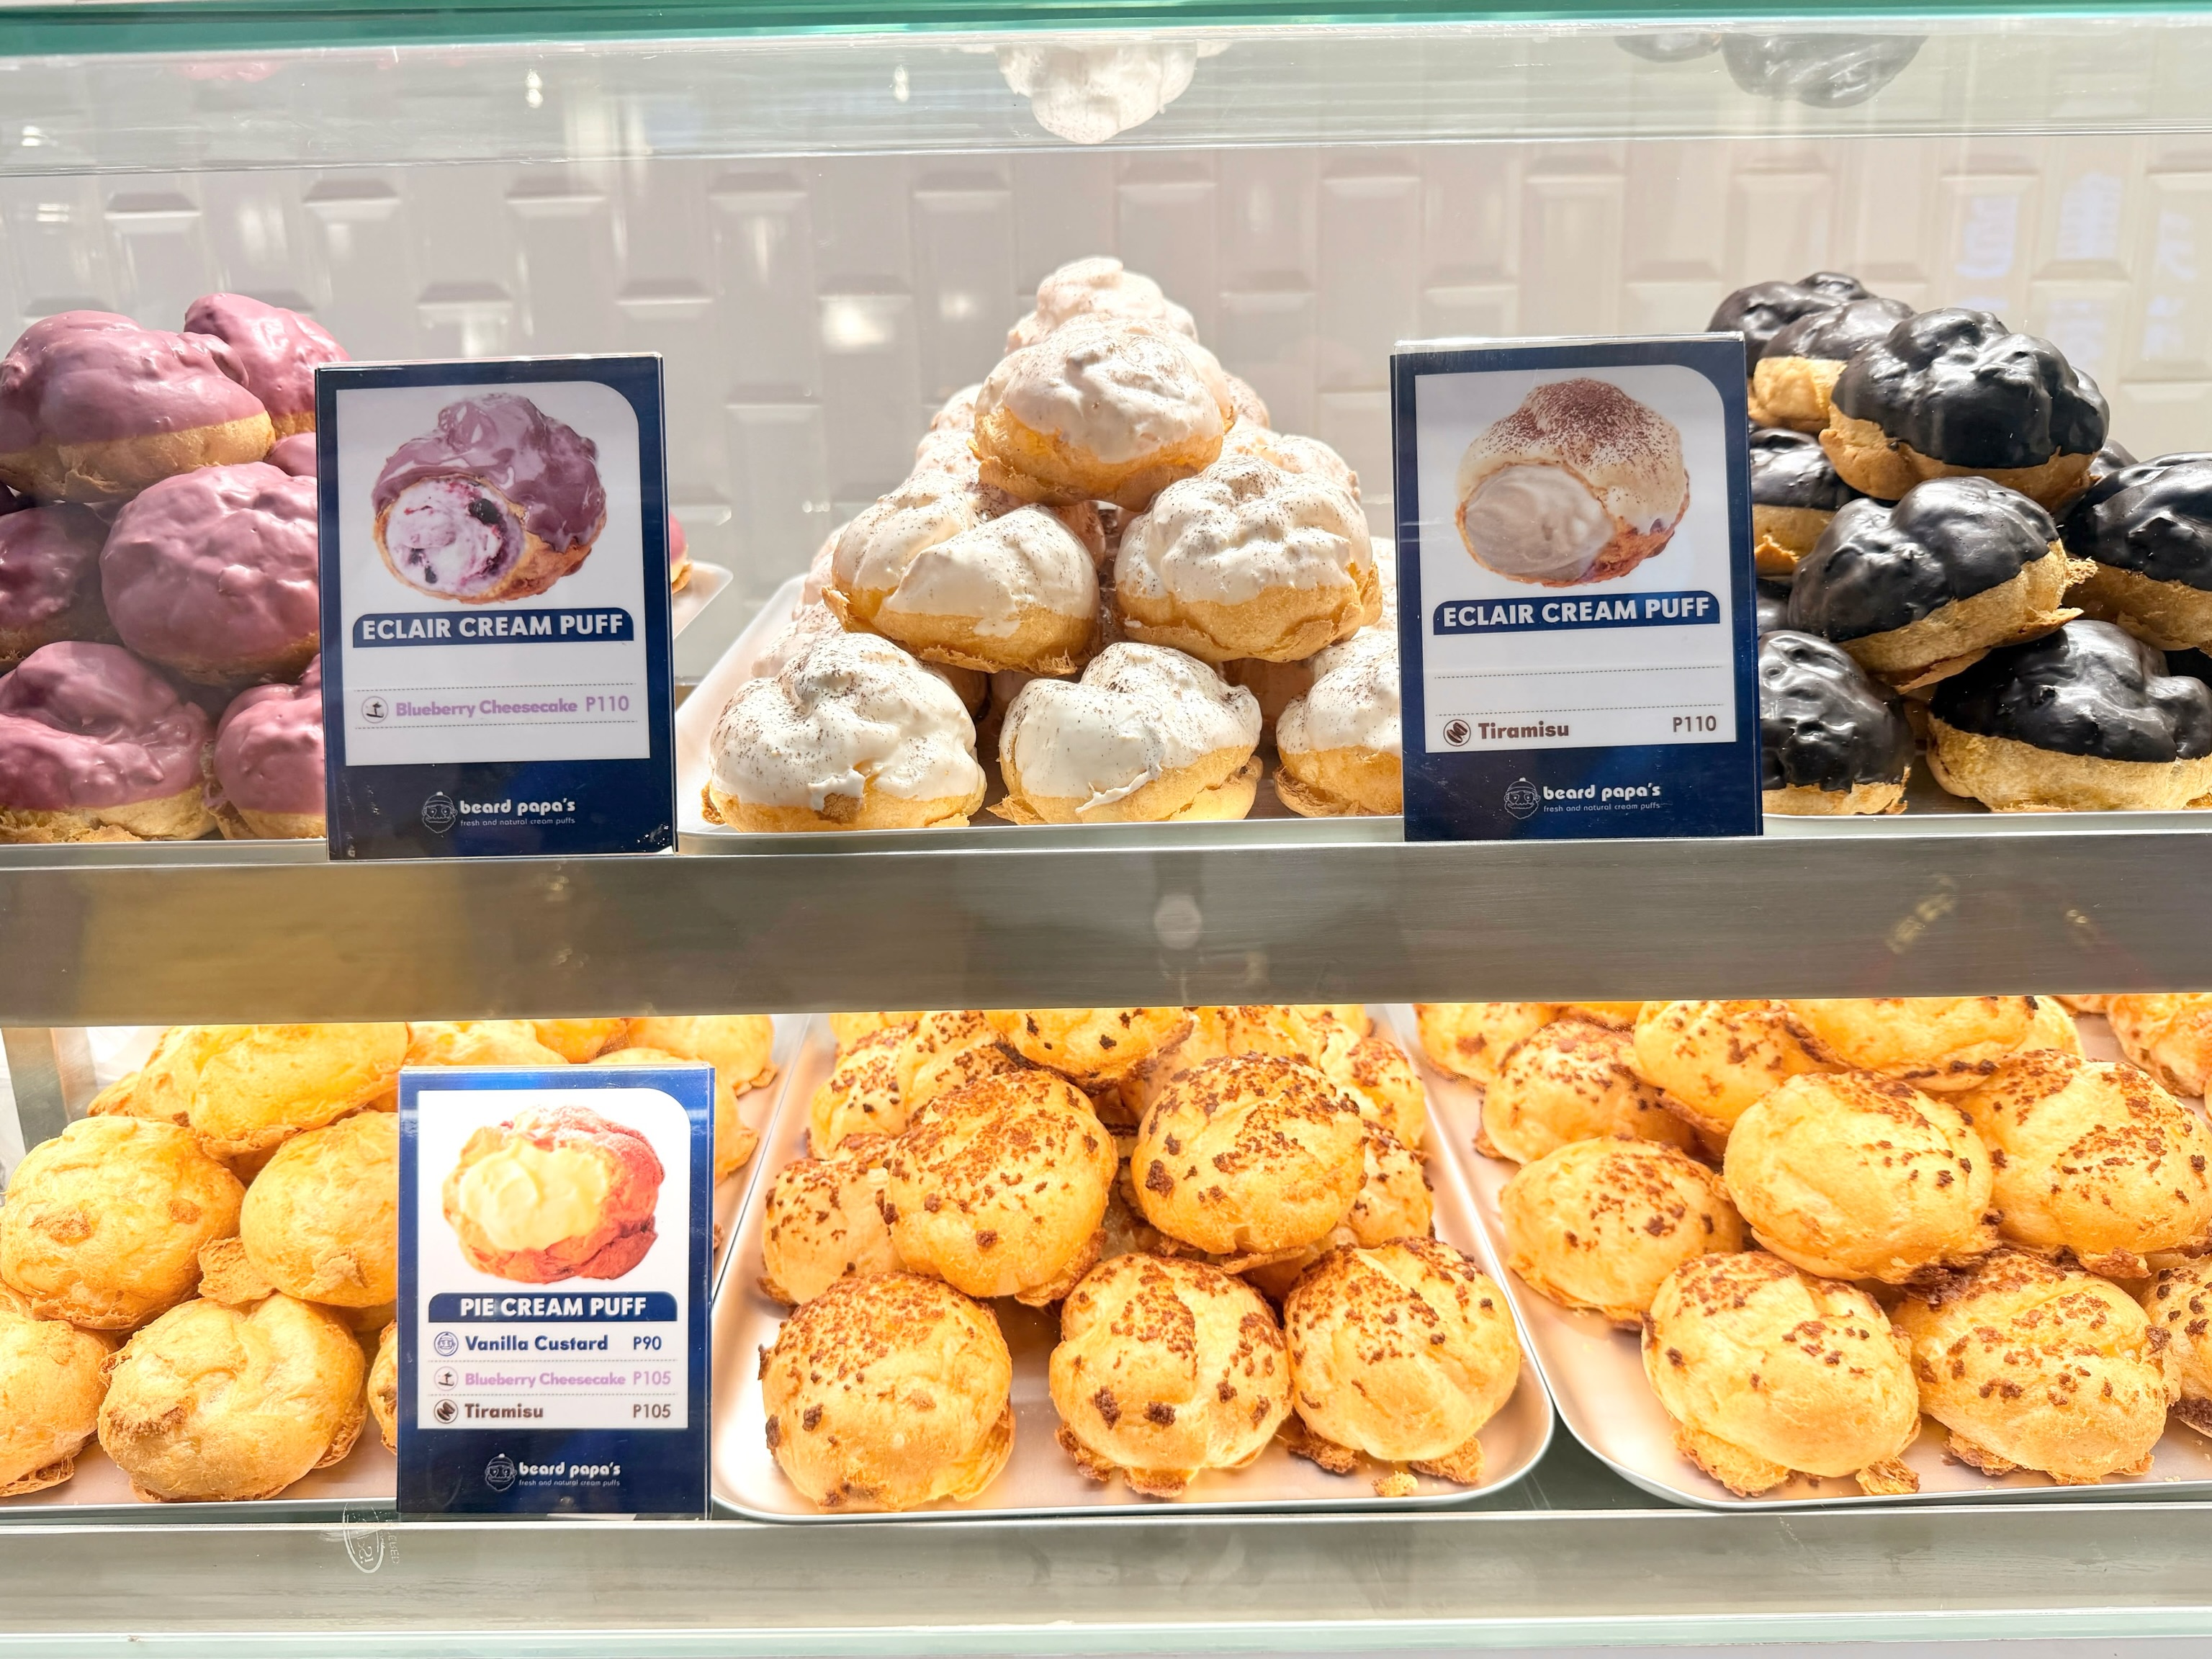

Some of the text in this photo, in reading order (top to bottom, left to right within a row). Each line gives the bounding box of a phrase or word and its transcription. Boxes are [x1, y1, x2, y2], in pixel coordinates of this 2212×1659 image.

[1444, 598, 1709, 627] ECLAIR CREAM PUFF
[363, 614, 623, 640] ECLAIR CREAM PUFF
[397, 696, 629, 718] Blueberry Cheesecake P110
[1478, 716, 1716, 739] Tiramisu P110
[1543, 783, 1660, 801] beard papa's
[460, 798, 575, 816] beard papa's
[1640, 802, 1660, 811] puffs
[556, 817, 575, 826] puffs
[461, 1297, 647, 1316] PIE CREAM PUFF
[465, 1336, 661, 1351] Vanilla Custard P90
[465, 1371, 671, 1388] Blueberry Cheesecake P105
[465, 1403, 671, 1418] Tiramisu P105
[519, 1462, 621, 1477] beard papa's
